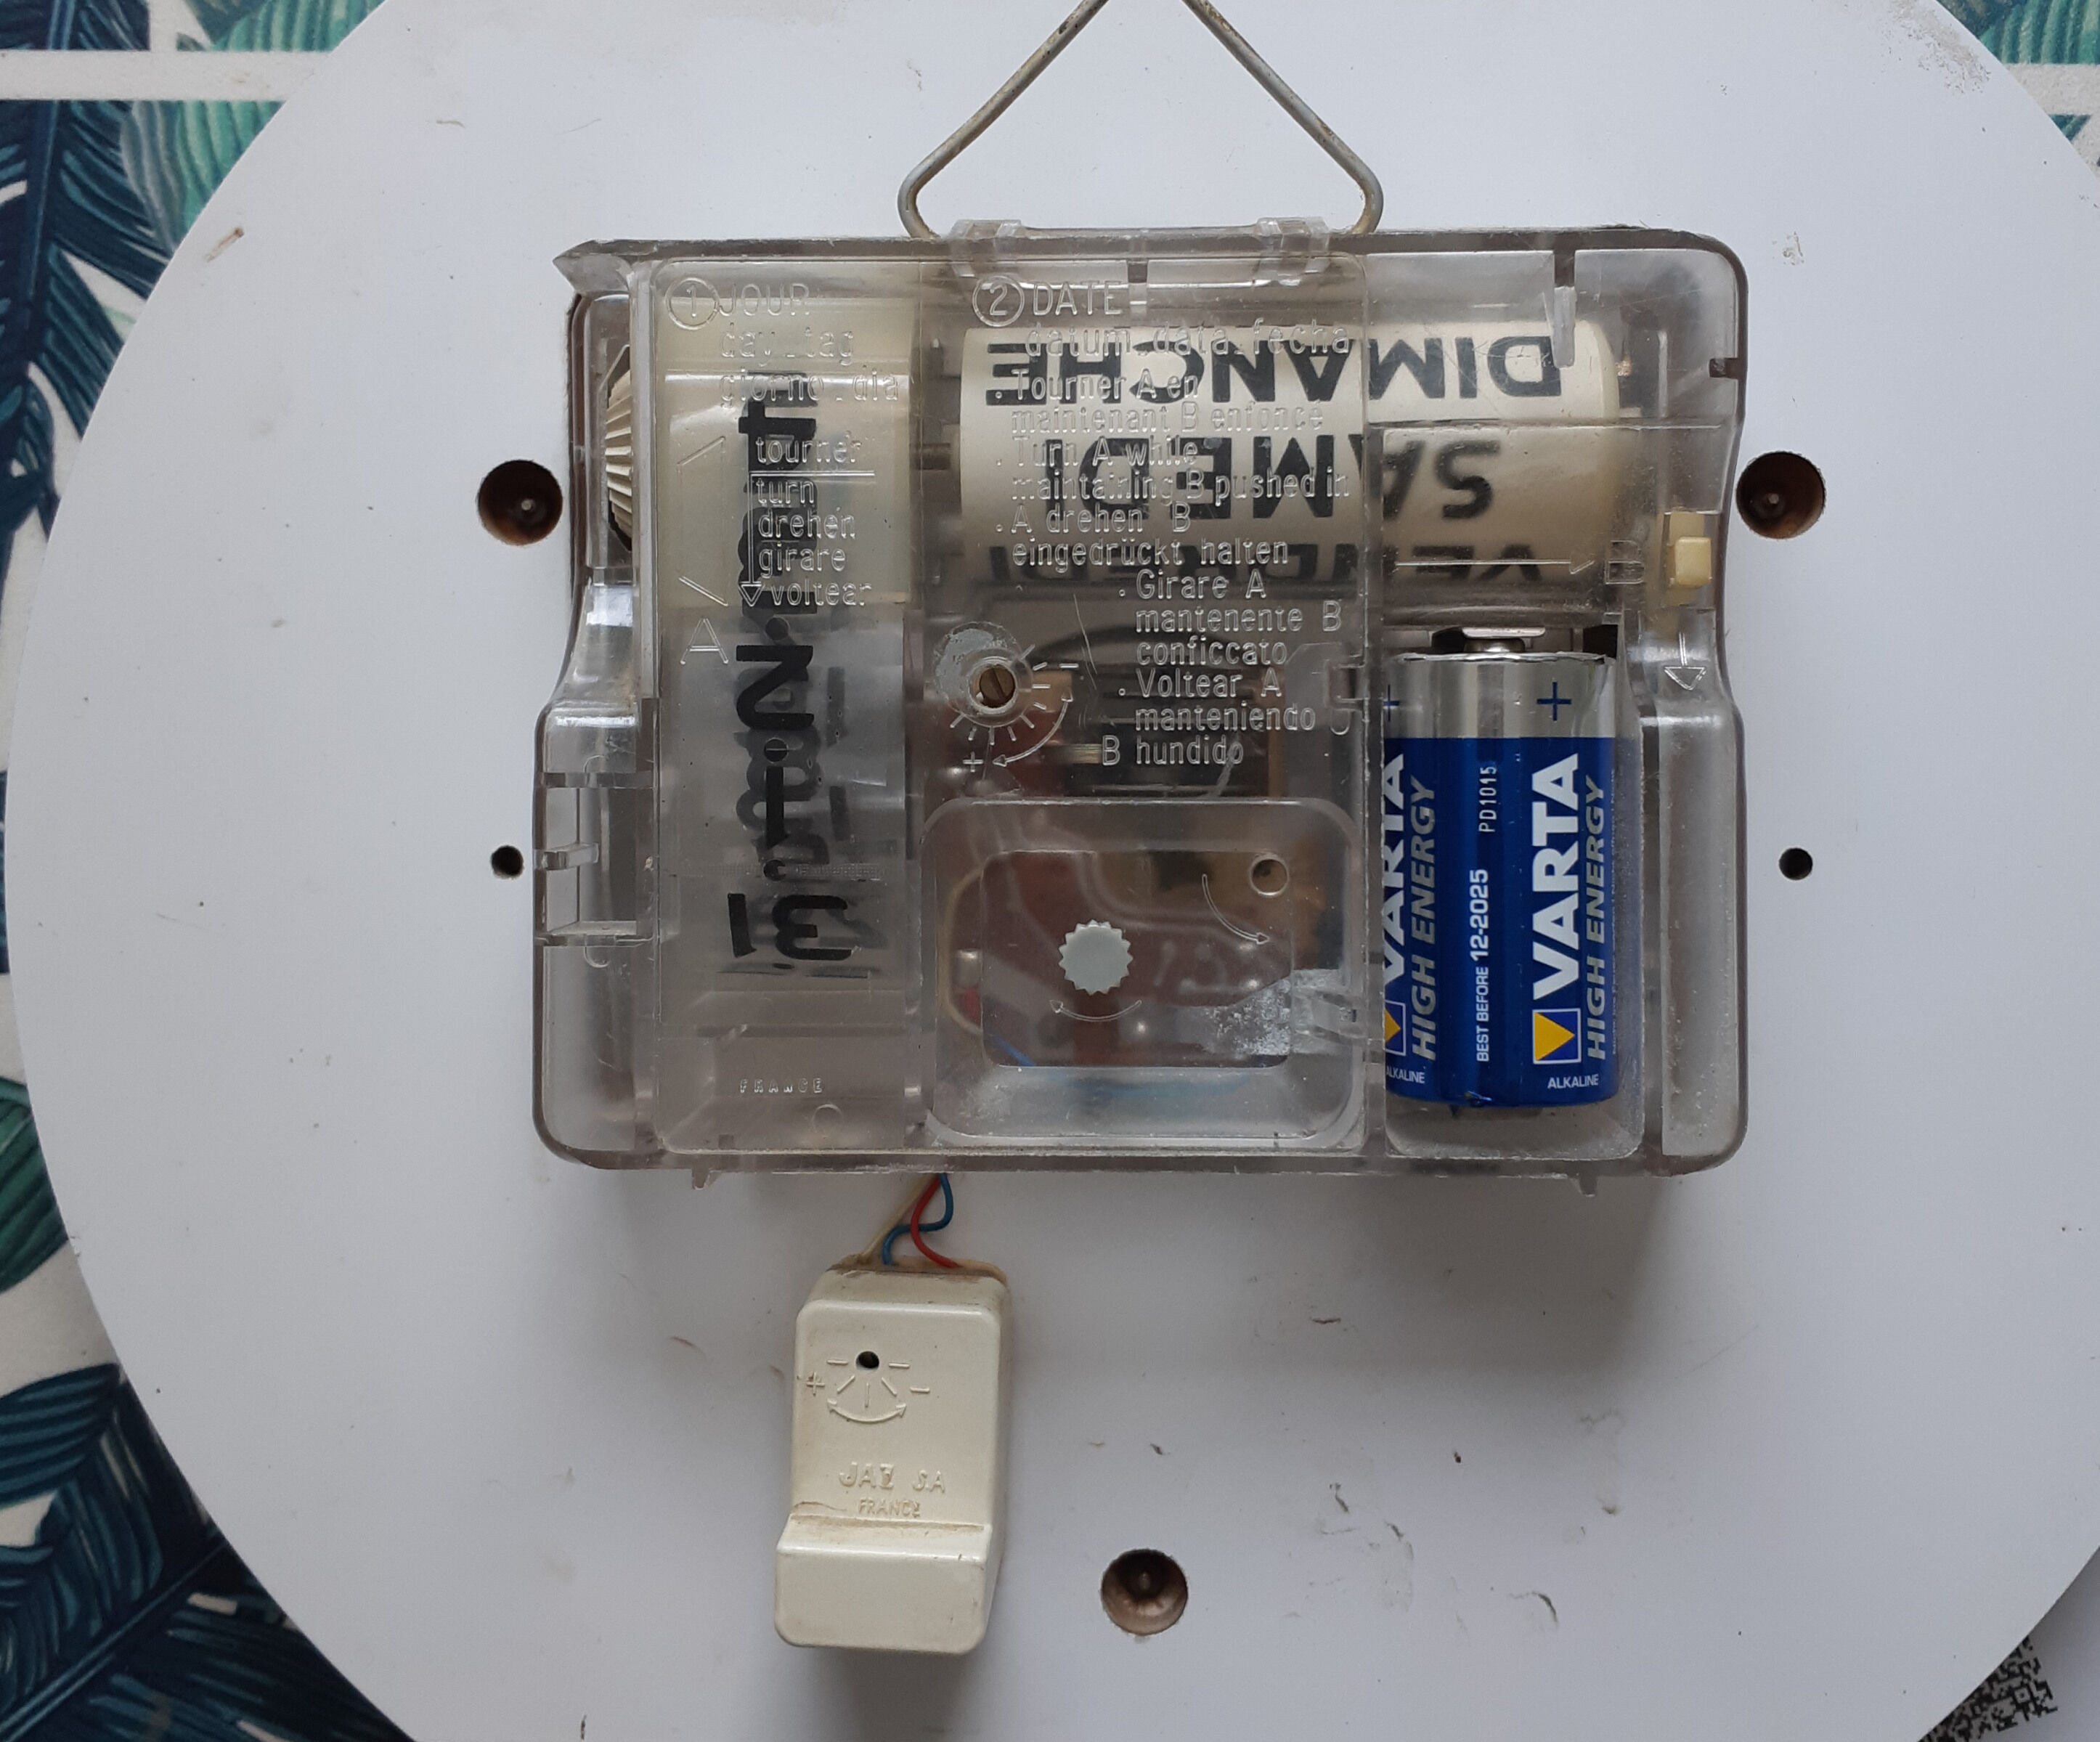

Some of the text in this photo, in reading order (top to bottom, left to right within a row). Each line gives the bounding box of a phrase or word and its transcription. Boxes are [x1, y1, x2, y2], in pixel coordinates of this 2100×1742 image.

[719, 283, 812, 317] JOUR
[1033, 280, 1123, 316] DATE
[804, 326, 855, 366] tag
[1254, 317, 1350, 354] fecha
[986, 335, 1562, 407] DIMANCHE
[1012, 368, 1199, 400] Tourner A en
[720, 367, 824, 410] giorno
[1012, 407, 1171, 434] maintenant
[1181, 401, 1198, 433] B
[755, 436, 863, 463] tourner
[1012, 434, 1198, 467] Turn A while
[756, 479, 815, 504] turn
[1012, 466, 1350, 507] maintaining B pushed in
[1045, 434, 1500, 521] SAMEDI
[758, 508, 857, 539] drehen
[1012, 501, 1192, 534] A drehen B
[759, 542, 847, 579] girare
[1012, 536, 1289, 574] eingedrückt halten
[771, 579, 872, 606] voltear
[1136, 569, 1267, 599] Girare A
[1135, 600, 1343, 633] mantenente B
[679, 617, 729, 666] A
[1136, 635, 1288, 666] conficcato
[1135, 667, 1283, 699] Voltear A
[1135, 699, 1316, 731] manteniendo
[1101, 733, 1244, 767] B hundido
[1478, 766, 1497, 833] PD1015
[1531, 752, 1579, 1001] VARTA
[1410, 775, 1436, 1061] HIGH ENERGY
[1585, 775, 1605, 1061] HIGH ENERGY
[1470, 868, 1489, 1062] BEST BEFORE 12-2025
[739, 1078, 823, 1094] FRANCE
[1547, 1073, 1599, 1089] ALKALINE
[839, 1461, 895, 1490] JAZ
[858, 1497, 921, 1518] FRANCE
